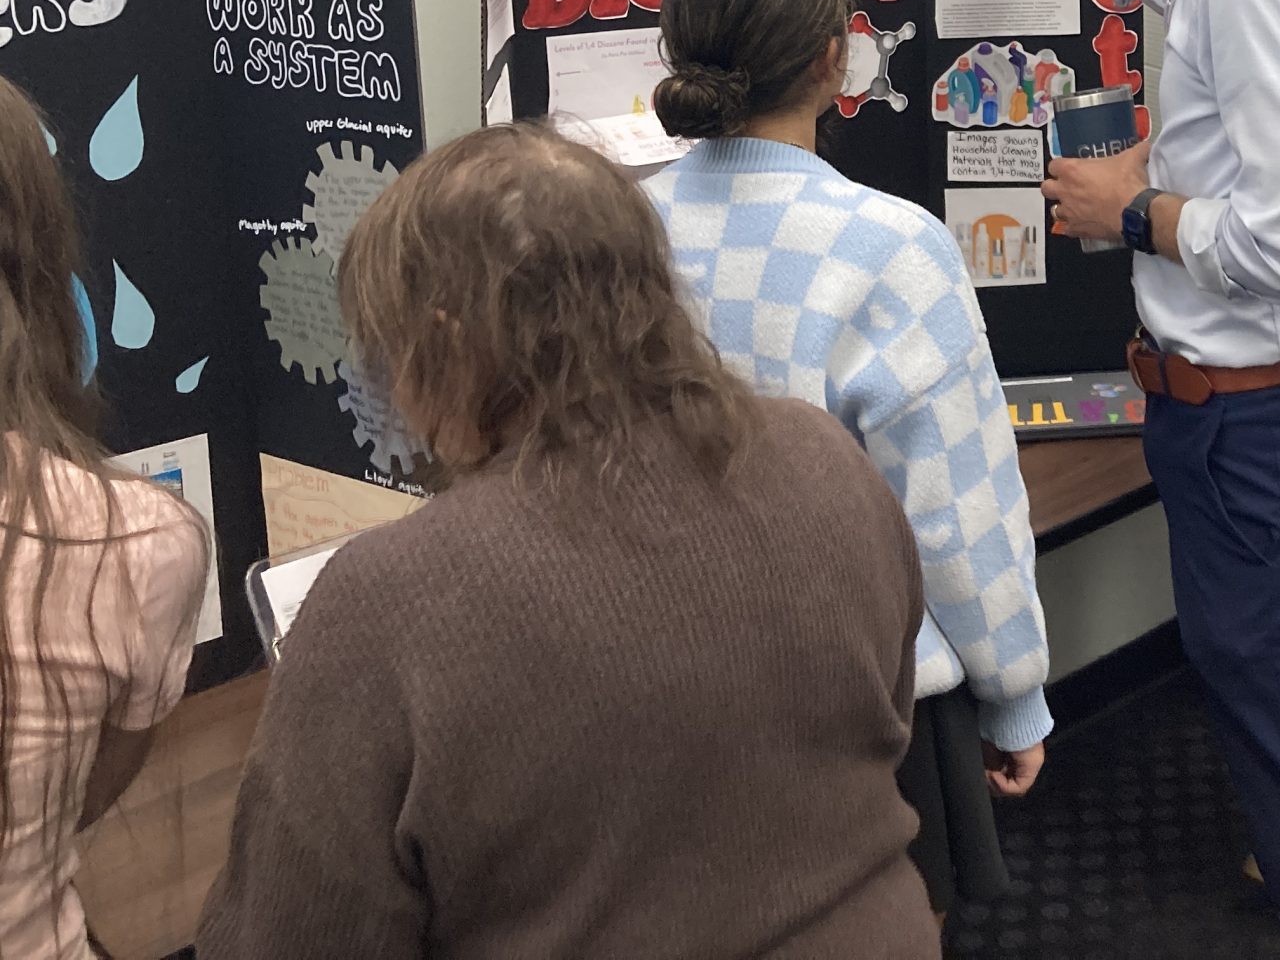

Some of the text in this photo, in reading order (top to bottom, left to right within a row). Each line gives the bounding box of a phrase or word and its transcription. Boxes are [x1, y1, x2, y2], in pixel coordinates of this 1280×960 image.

[213, 37, 401, 102] A SYSTEM
[954, 132, 997, 147] Images
[952, 146, 997, 154] Household
[998, 156, 1016, 166] that
[1020, 159, 1040, 172] may
[365, 469, 393, 487] Lloyd
